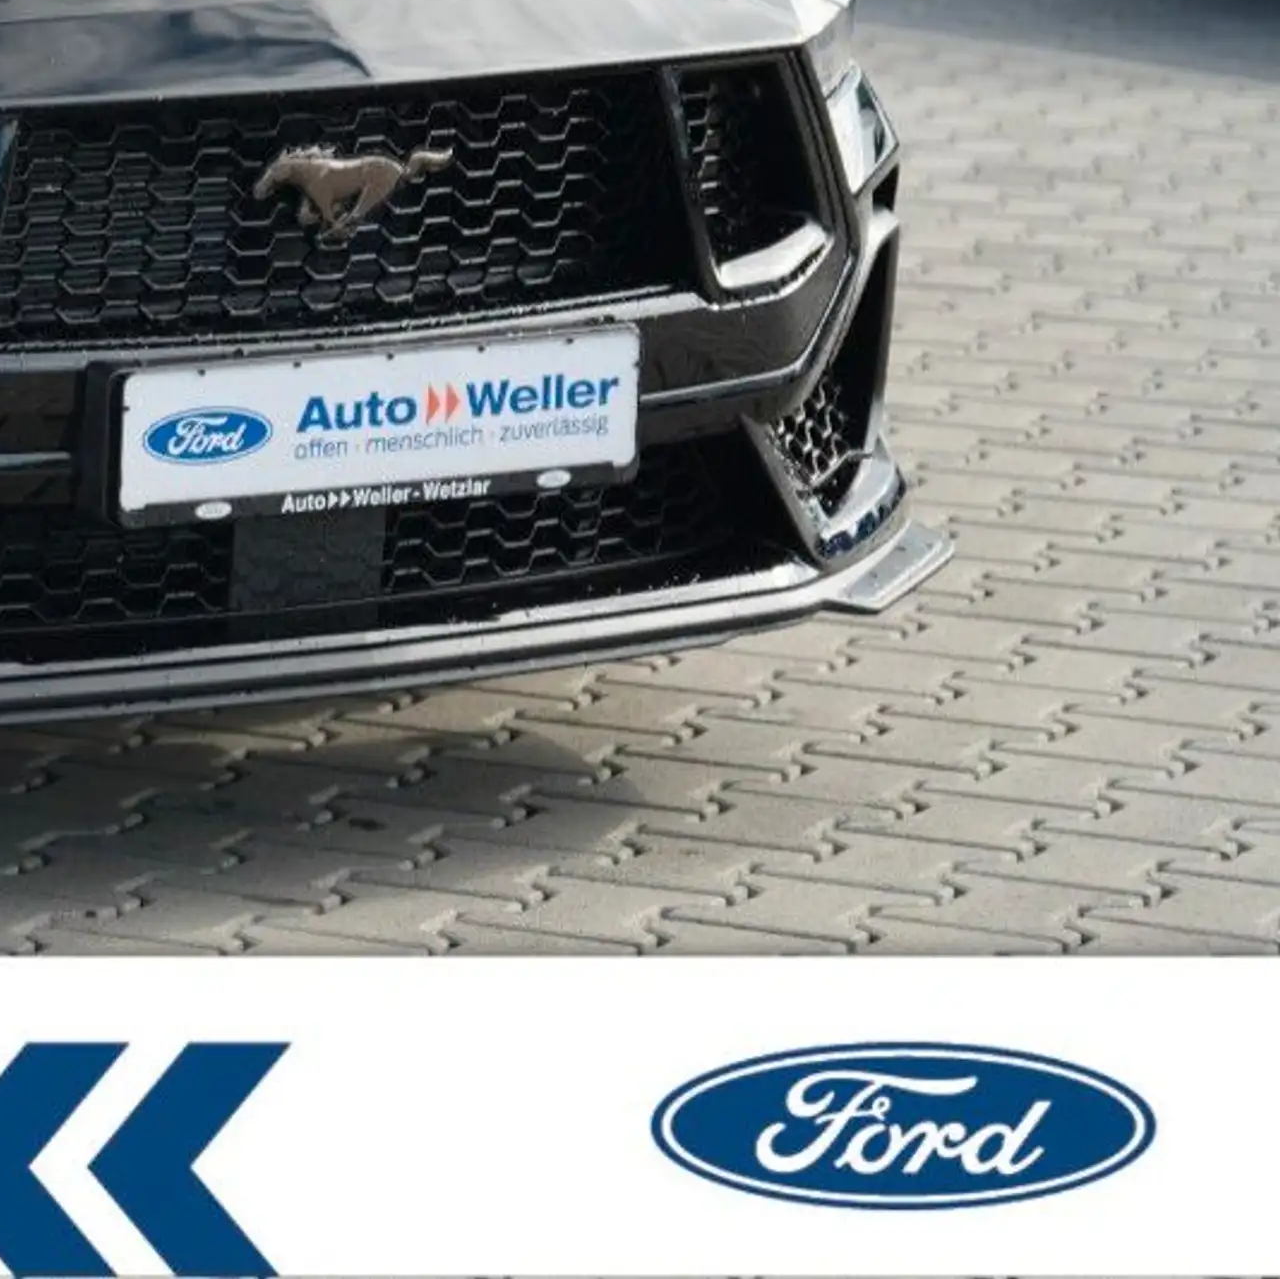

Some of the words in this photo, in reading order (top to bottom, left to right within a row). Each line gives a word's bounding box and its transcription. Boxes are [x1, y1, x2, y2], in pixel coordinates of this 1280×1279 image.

[296, 391, 418, 433] Auto
[466, 372, 620, 418] Weller
[168, 415, 248, 456] Ford
[293, 438, 349, 460] offen
[364, 424, 484, 454] menschlich
[280, 490, 328, 515] Auto
[352, 483, 413, 507] Weller
[422, 477, 492, 502] Wetzlar
